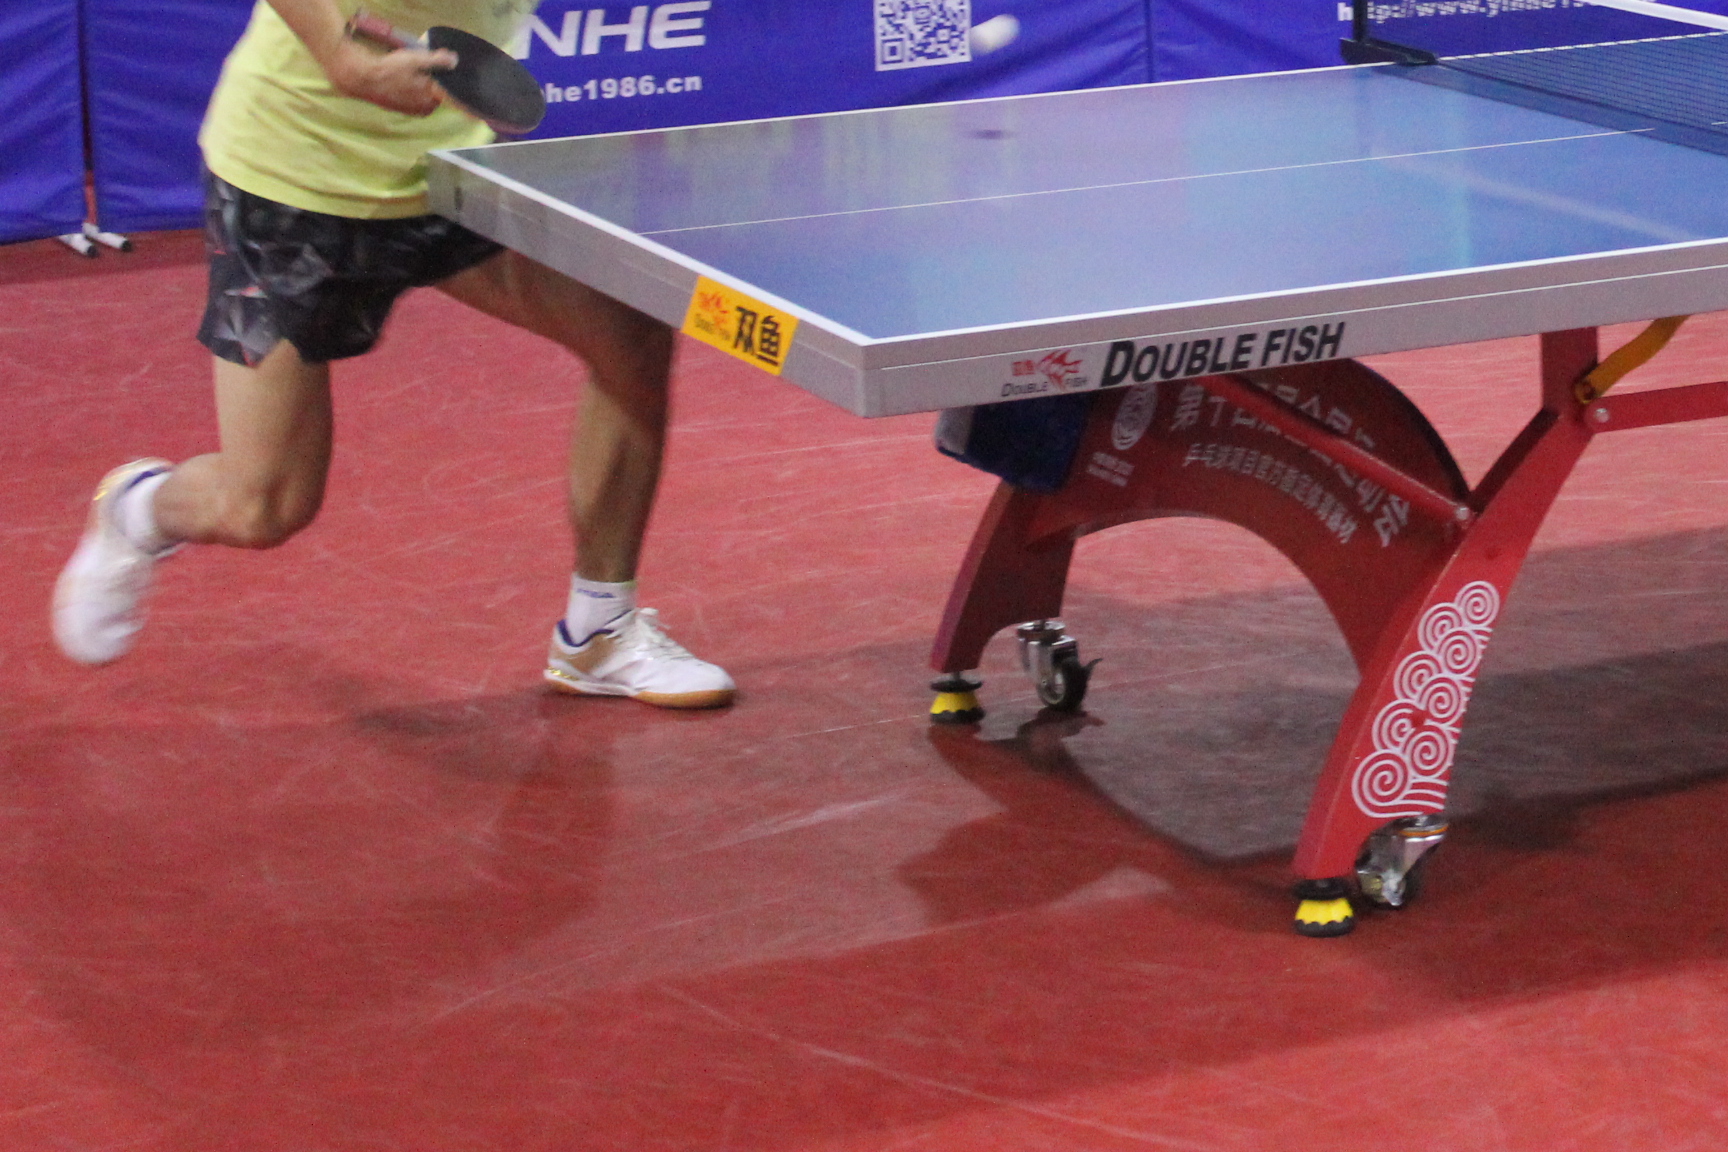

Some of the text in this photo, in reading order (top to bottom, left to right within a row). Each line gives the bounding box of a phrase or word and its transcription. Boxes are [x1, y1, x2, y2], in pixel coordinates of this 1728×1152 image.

[510, 0, 712, 60] NHE
[541, 75, 703, 104] he1986.cn
[733, 305, 781, 367] 双鱼
[1101, 322, 1346, 387] DOUBLE FISH
